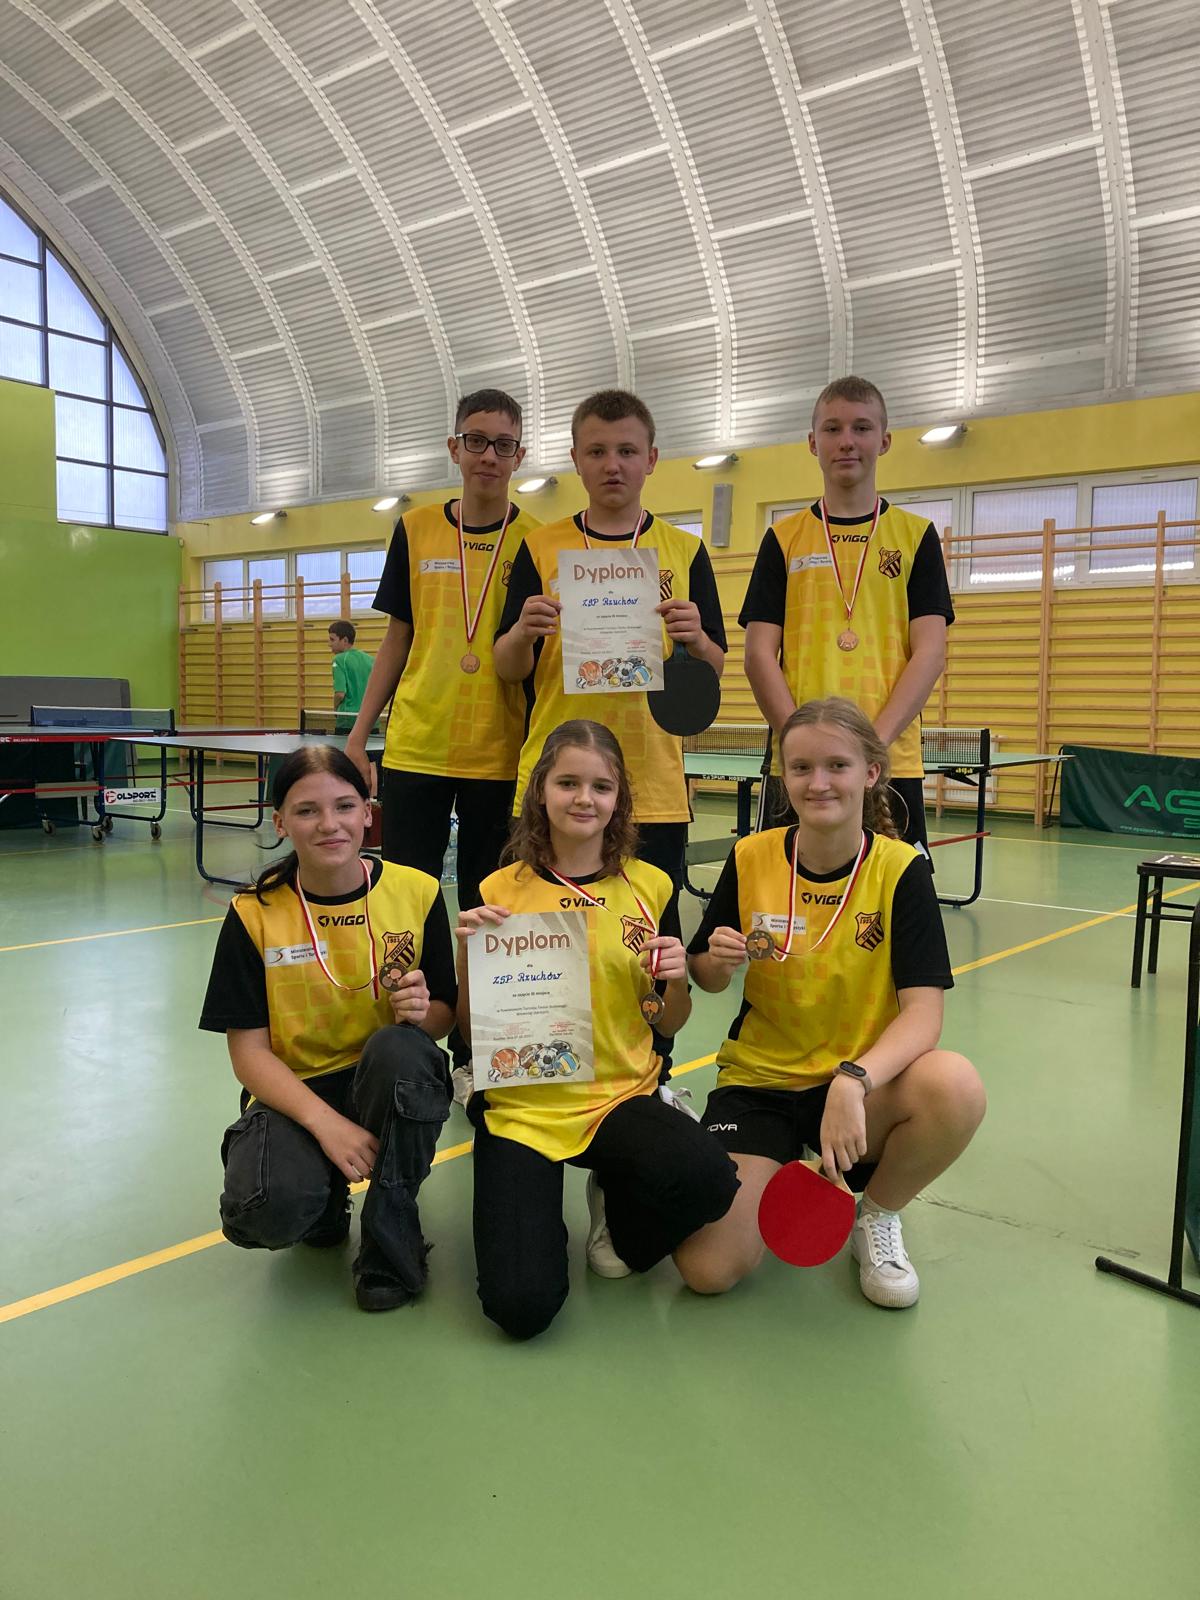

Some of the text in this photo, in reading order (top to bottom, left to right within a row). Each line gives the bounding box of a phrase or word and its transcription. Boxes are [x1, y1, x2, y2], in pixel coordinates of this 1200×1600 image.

[573, 563, 644, 583] Dyplom
[485, 931, 571, 956] Dyplom
[493, 970, 563, 985] ZSP Rzuchów
